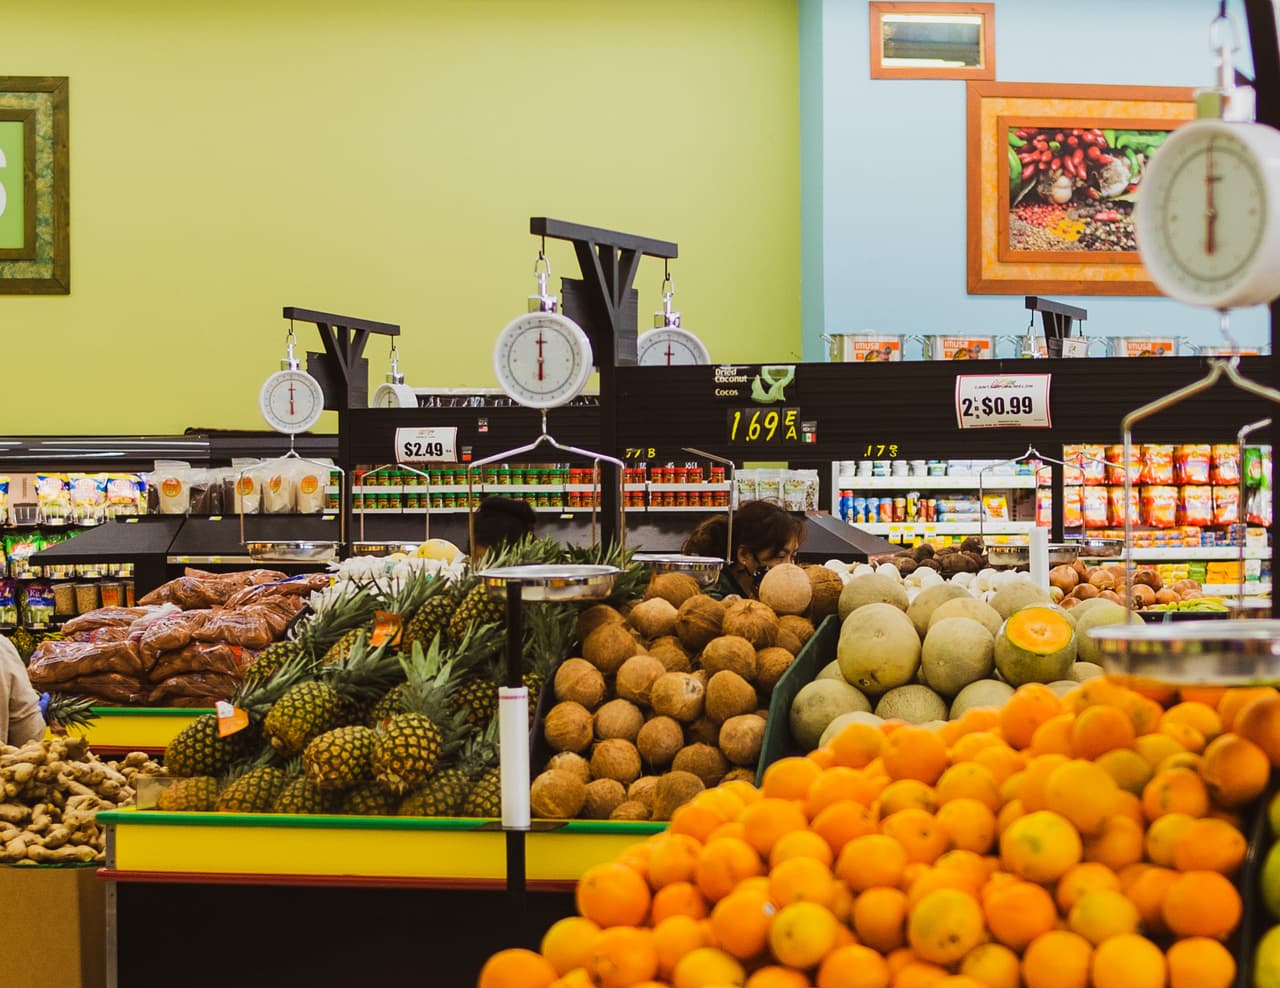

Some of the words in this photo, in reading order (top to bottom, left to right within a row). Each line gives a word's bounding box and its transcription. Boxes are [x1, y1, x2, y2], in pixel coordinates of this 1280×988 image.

[715, 367, 737, 376] Dried
[715, 375, 748, 383] Coconut
[715, 388, 738, 396] Cocos
[962, 398, 974, 417] 2
[981, 396, 1033, 416] $0.99
[731, 411, 779, 441] 1.69
[404, 441, 443, 457] $2.49
